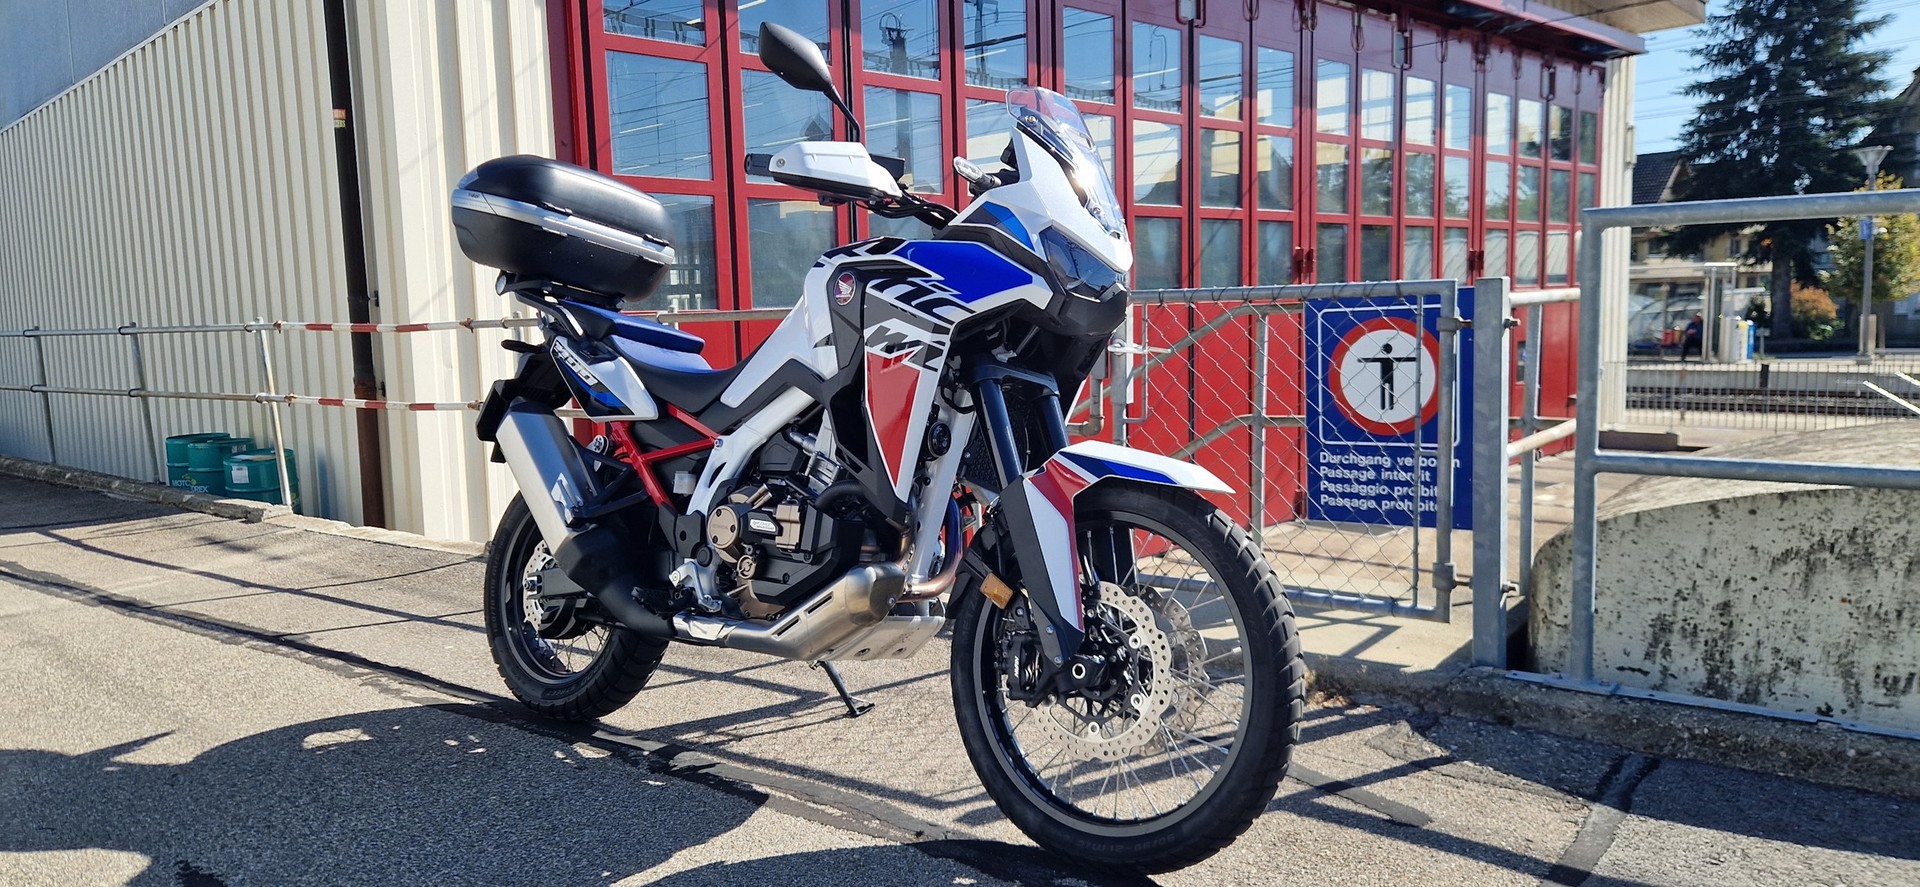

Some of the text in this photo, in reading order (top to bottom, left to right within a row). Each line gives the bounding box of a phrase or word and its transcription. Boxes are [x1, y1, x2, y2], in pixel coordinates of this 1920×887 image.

[1319, 451, 1460, 469] Durchgang vebon
[1319, 466, 1431, 482] Passage interit
[171, 479, 190, 487] MOTO
[1320, 480, 1389, 497] Passaggio
[1320, 494, 1377, 511] Passage
